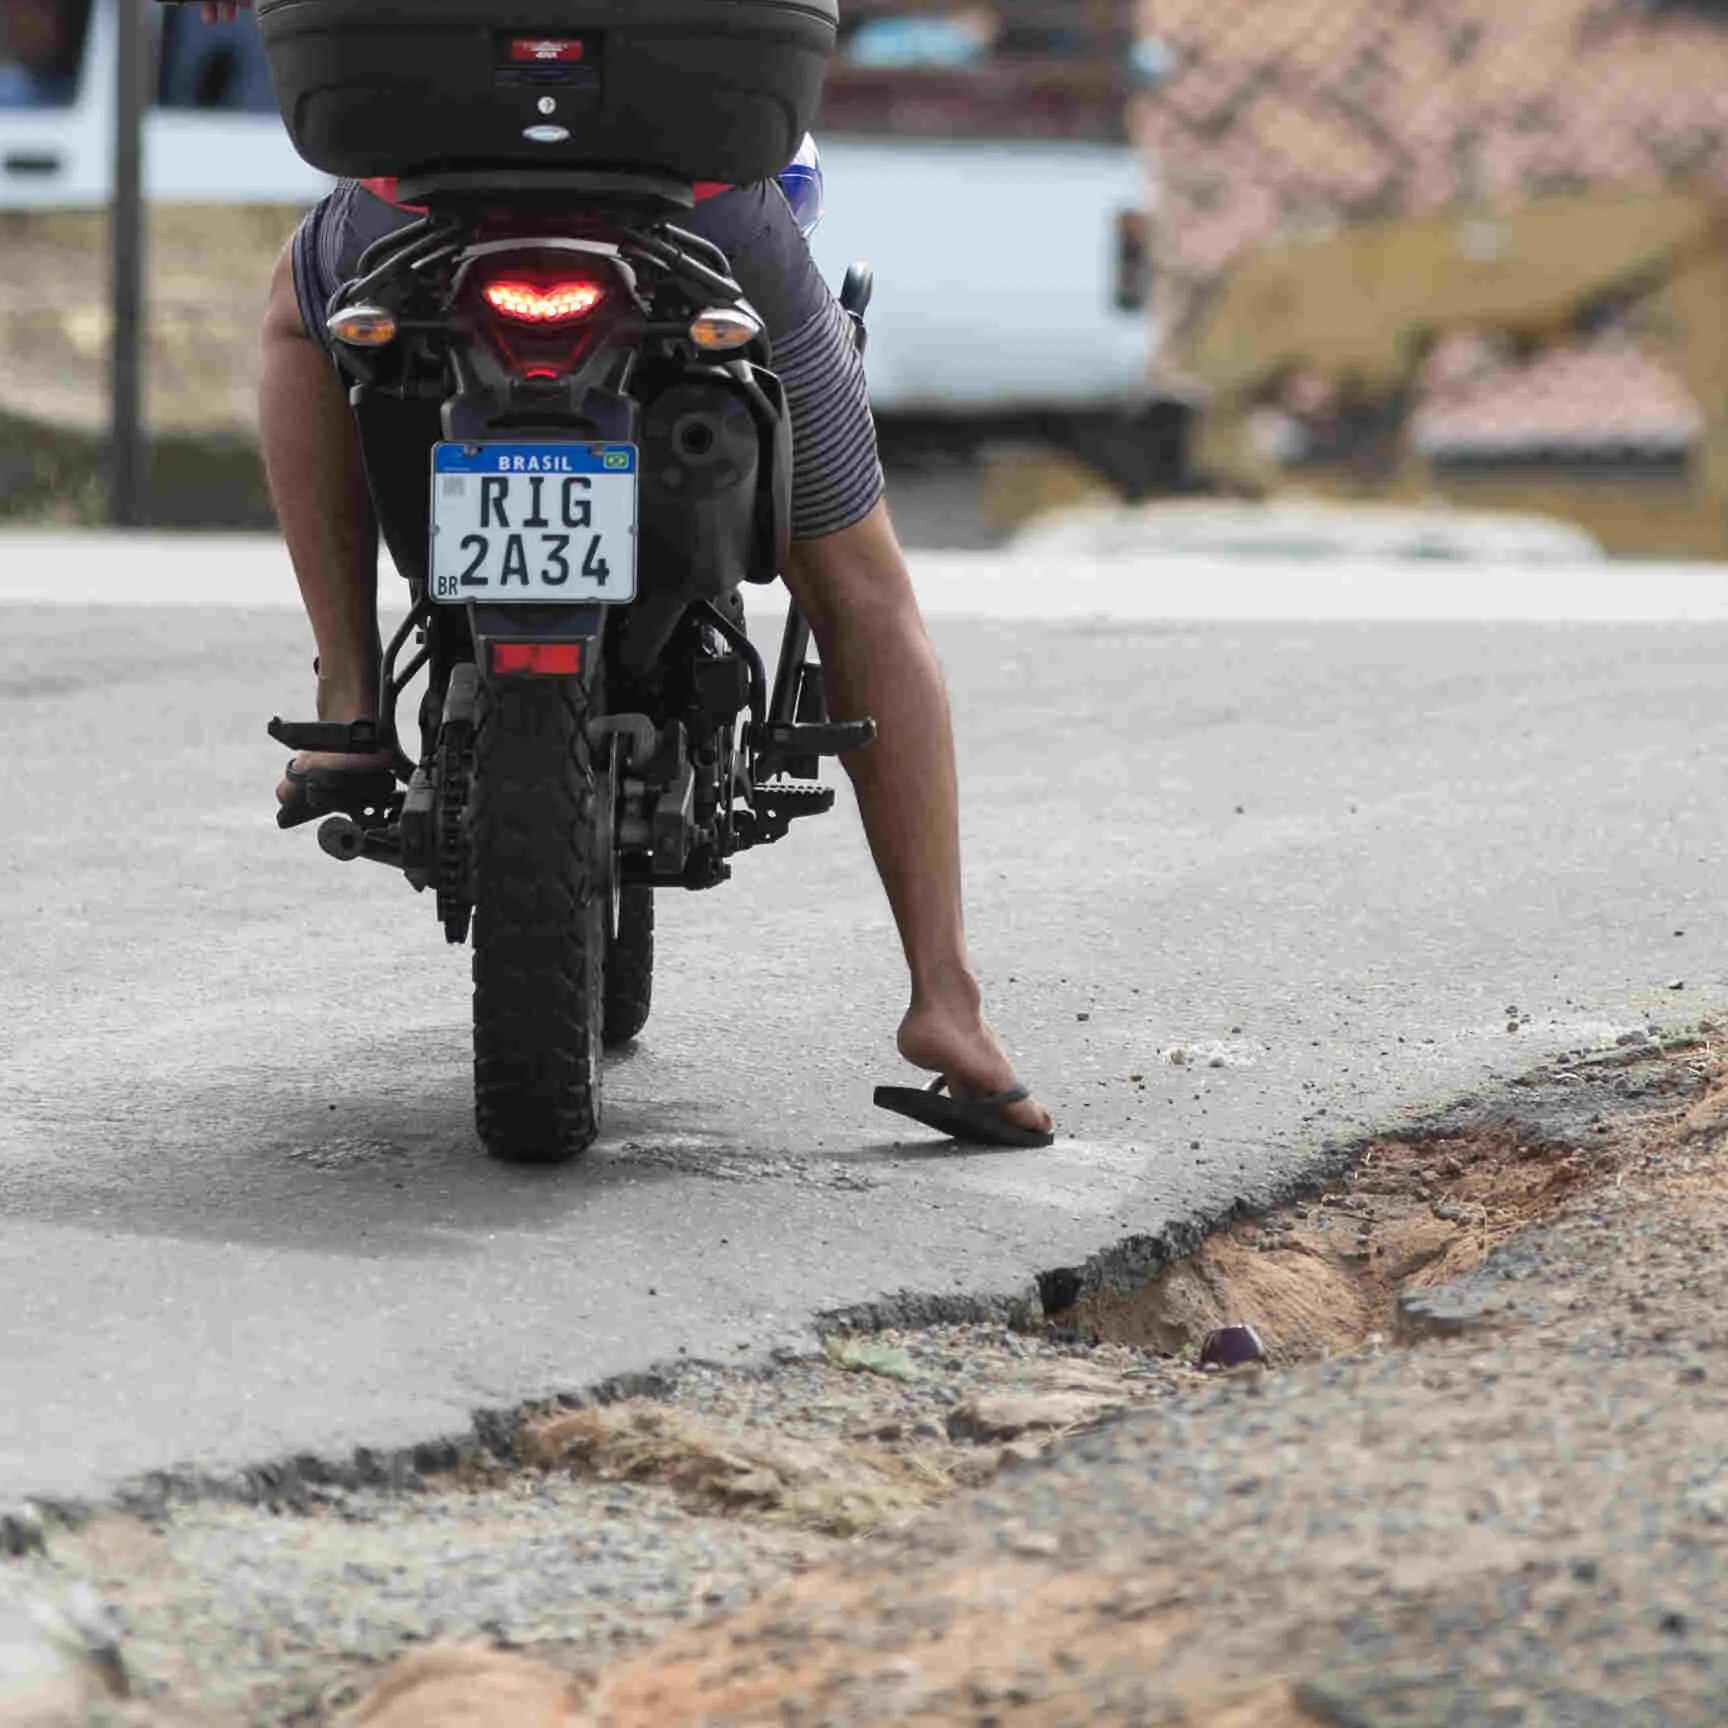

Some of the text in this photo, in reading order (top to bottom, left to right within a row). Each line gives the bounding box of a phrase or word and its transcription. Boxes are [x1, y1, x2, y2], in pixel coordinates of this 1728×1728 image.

[499, 455, 572, 471] BRASIL
[480, 476, 593, 528] RIG
[459, 534, 610, 587] 2A34
[438, 576, 458, 596] BR
